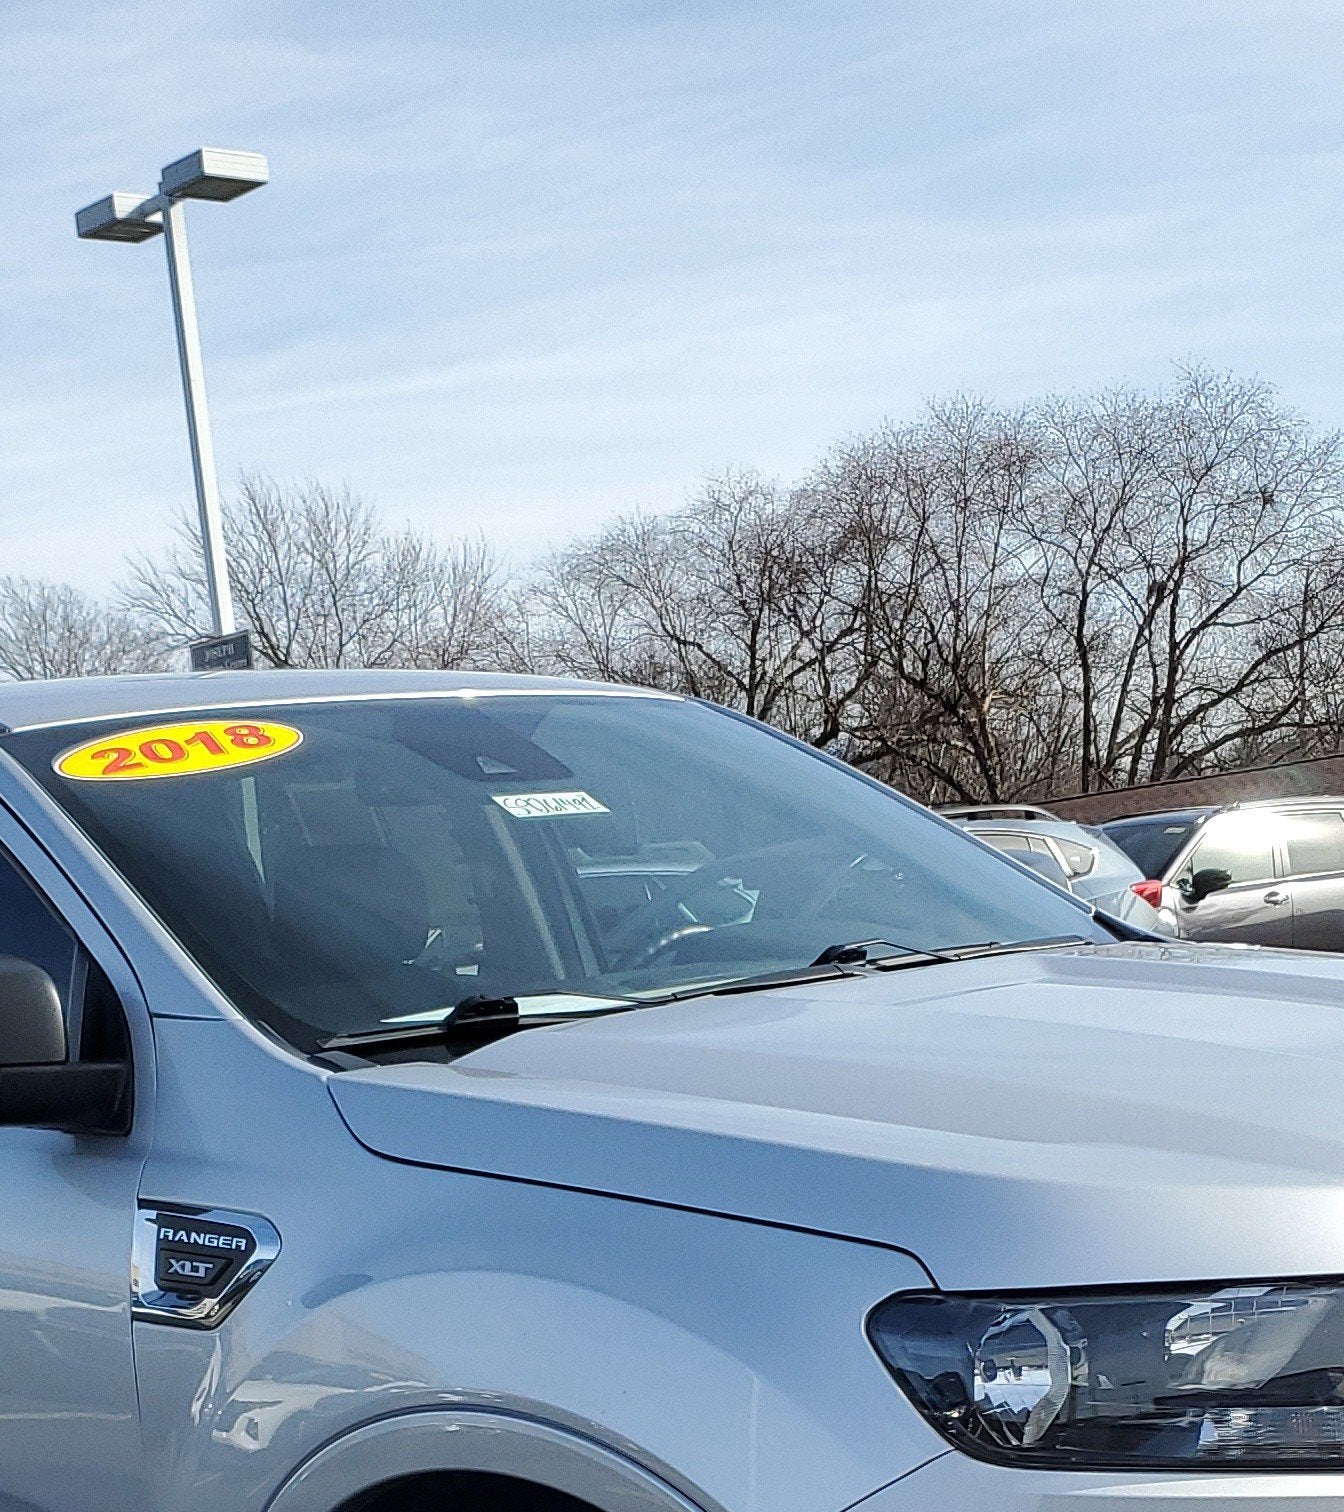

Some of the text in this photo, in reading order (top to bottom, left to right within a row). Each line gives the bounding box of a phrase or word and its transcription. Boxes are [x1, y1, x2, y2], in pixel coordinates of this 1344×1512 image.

[91, 725, 275, 775] 2018
[159, 1228, 247, 1250] RANGER
[167, 1258, 214, 1278] XLT
